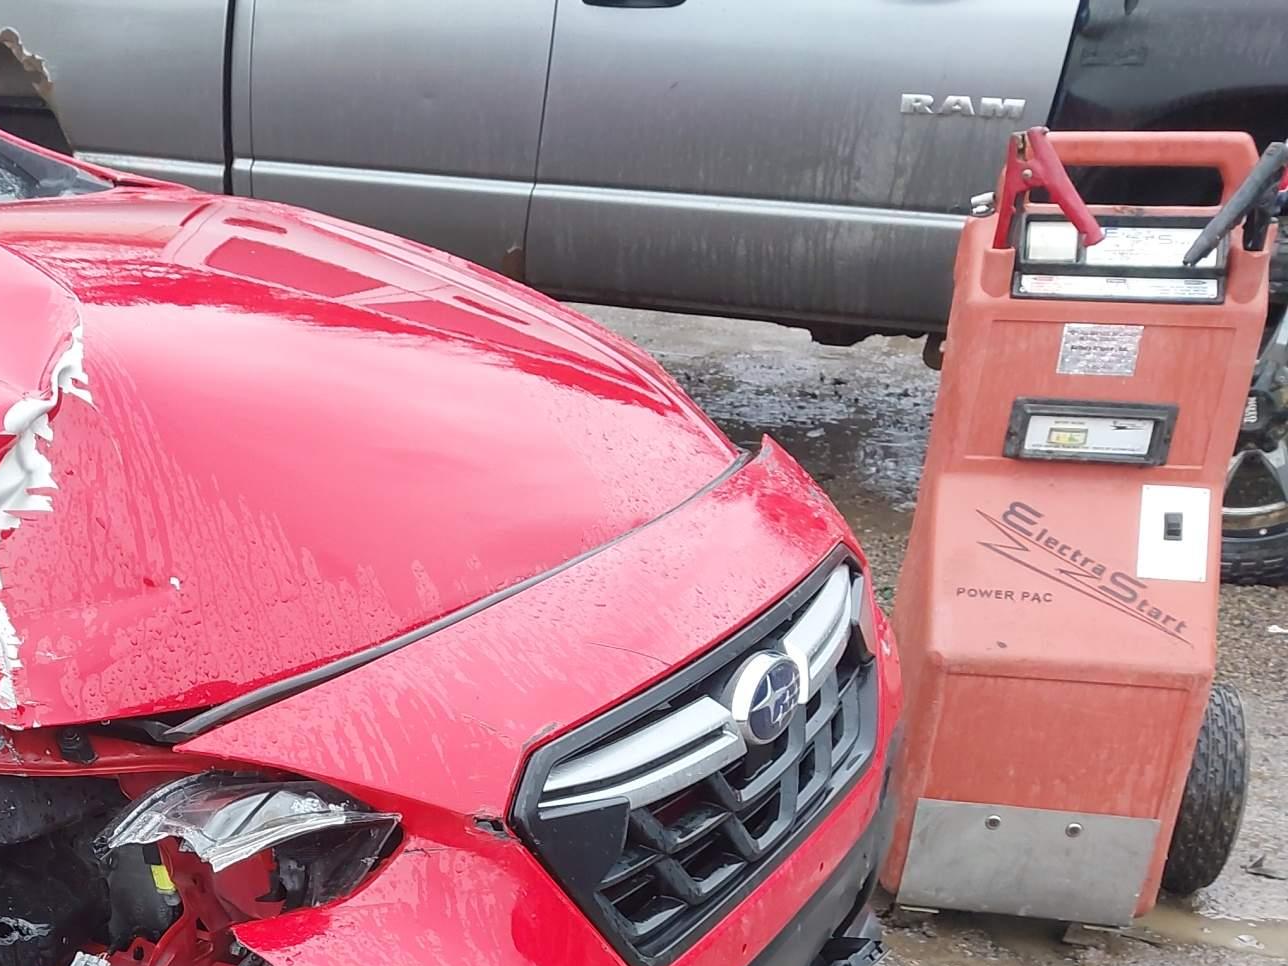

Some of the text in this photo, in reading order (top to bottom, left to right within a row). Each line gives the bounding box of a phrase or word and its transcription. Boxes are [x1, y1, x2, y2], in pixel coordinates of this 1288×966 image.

[900, 93, 1026, 118] RAM
[956, 587, 1054, 603] POWER PAC
